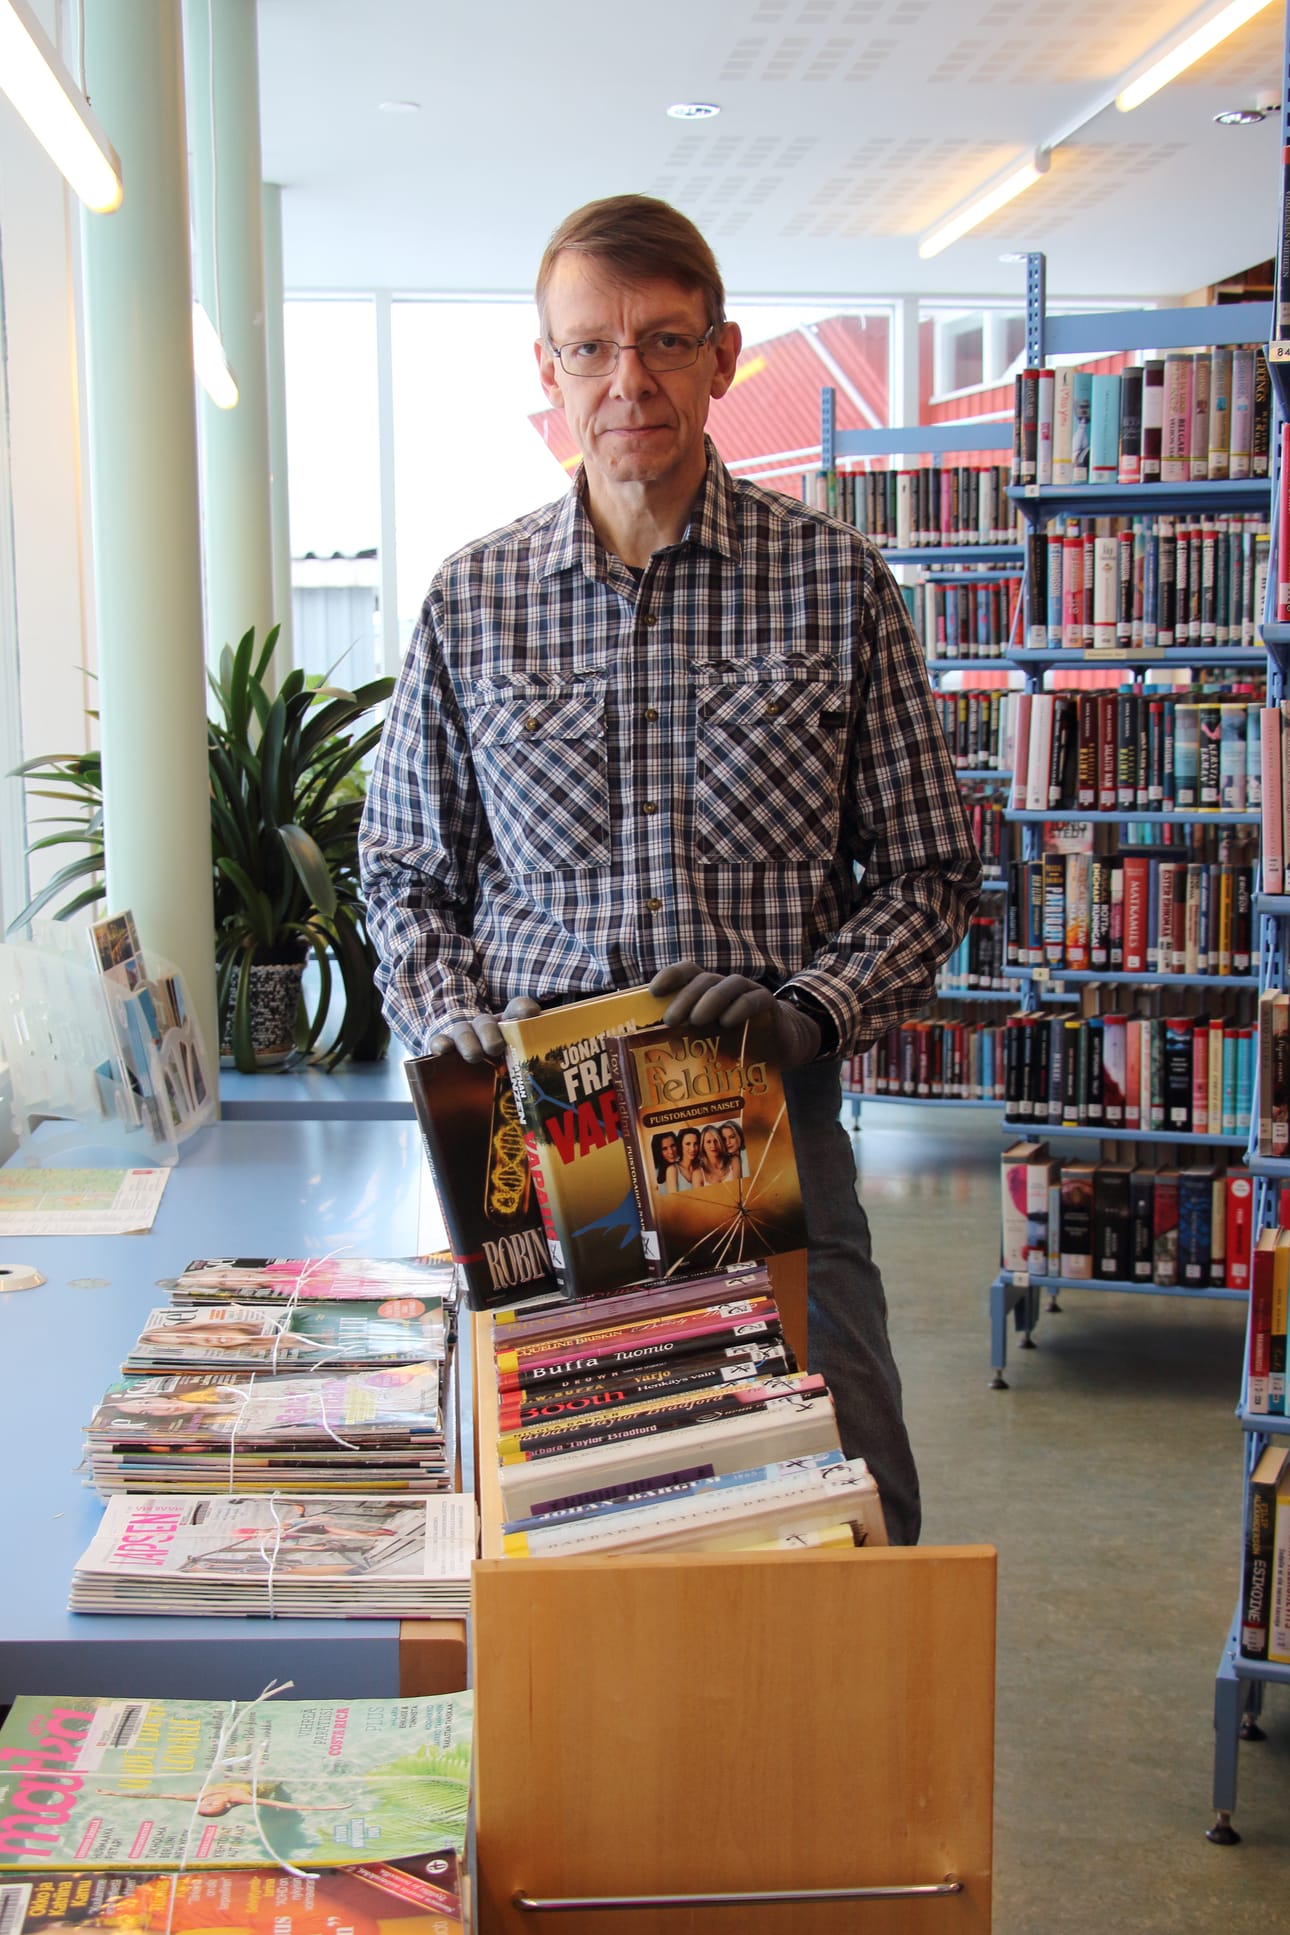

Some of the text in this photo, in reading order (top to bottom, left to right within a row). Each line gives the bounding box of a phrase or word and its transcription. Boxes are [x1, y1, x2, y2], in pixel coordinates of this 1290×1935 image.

[1128, 881, 1141, 948] MATKAMIES
[675, 1036, 720, 1062] Joy
[629, 1041, 767, 1110] Fielding
[649, 1100, 741, 1125] PUISTOKADUN NAISET
[576, 1331, 623, 1345] BRISKIN
[533, 1343, 674, 1379] Buffa Tuomio
[637, 1377, 689, 1392] Henkäys
[691, 1370, 716, 1380] vain
[530, 1424, 658, 1457] arbara Taylor Bradford
[1260, 1503, 1269, 1528] FILIP
[109, 1513, 182, 1566] LAPSEN
[298, 1708, 316, 1737] VIHREÄ
[314, 1707, 334, 1745] PARATIISI
[328, 1707, 350, 1756] COSTA RICA
[365, 1706, 384, 1732] PLUS
[145, 1826, 167, 1859] TUKHOLMA
[28, 1882, 55, 1917] Okko ja
[48, 1881, 72, 1917] Katriina
[71, 1880, 92, 1907] Kamu
